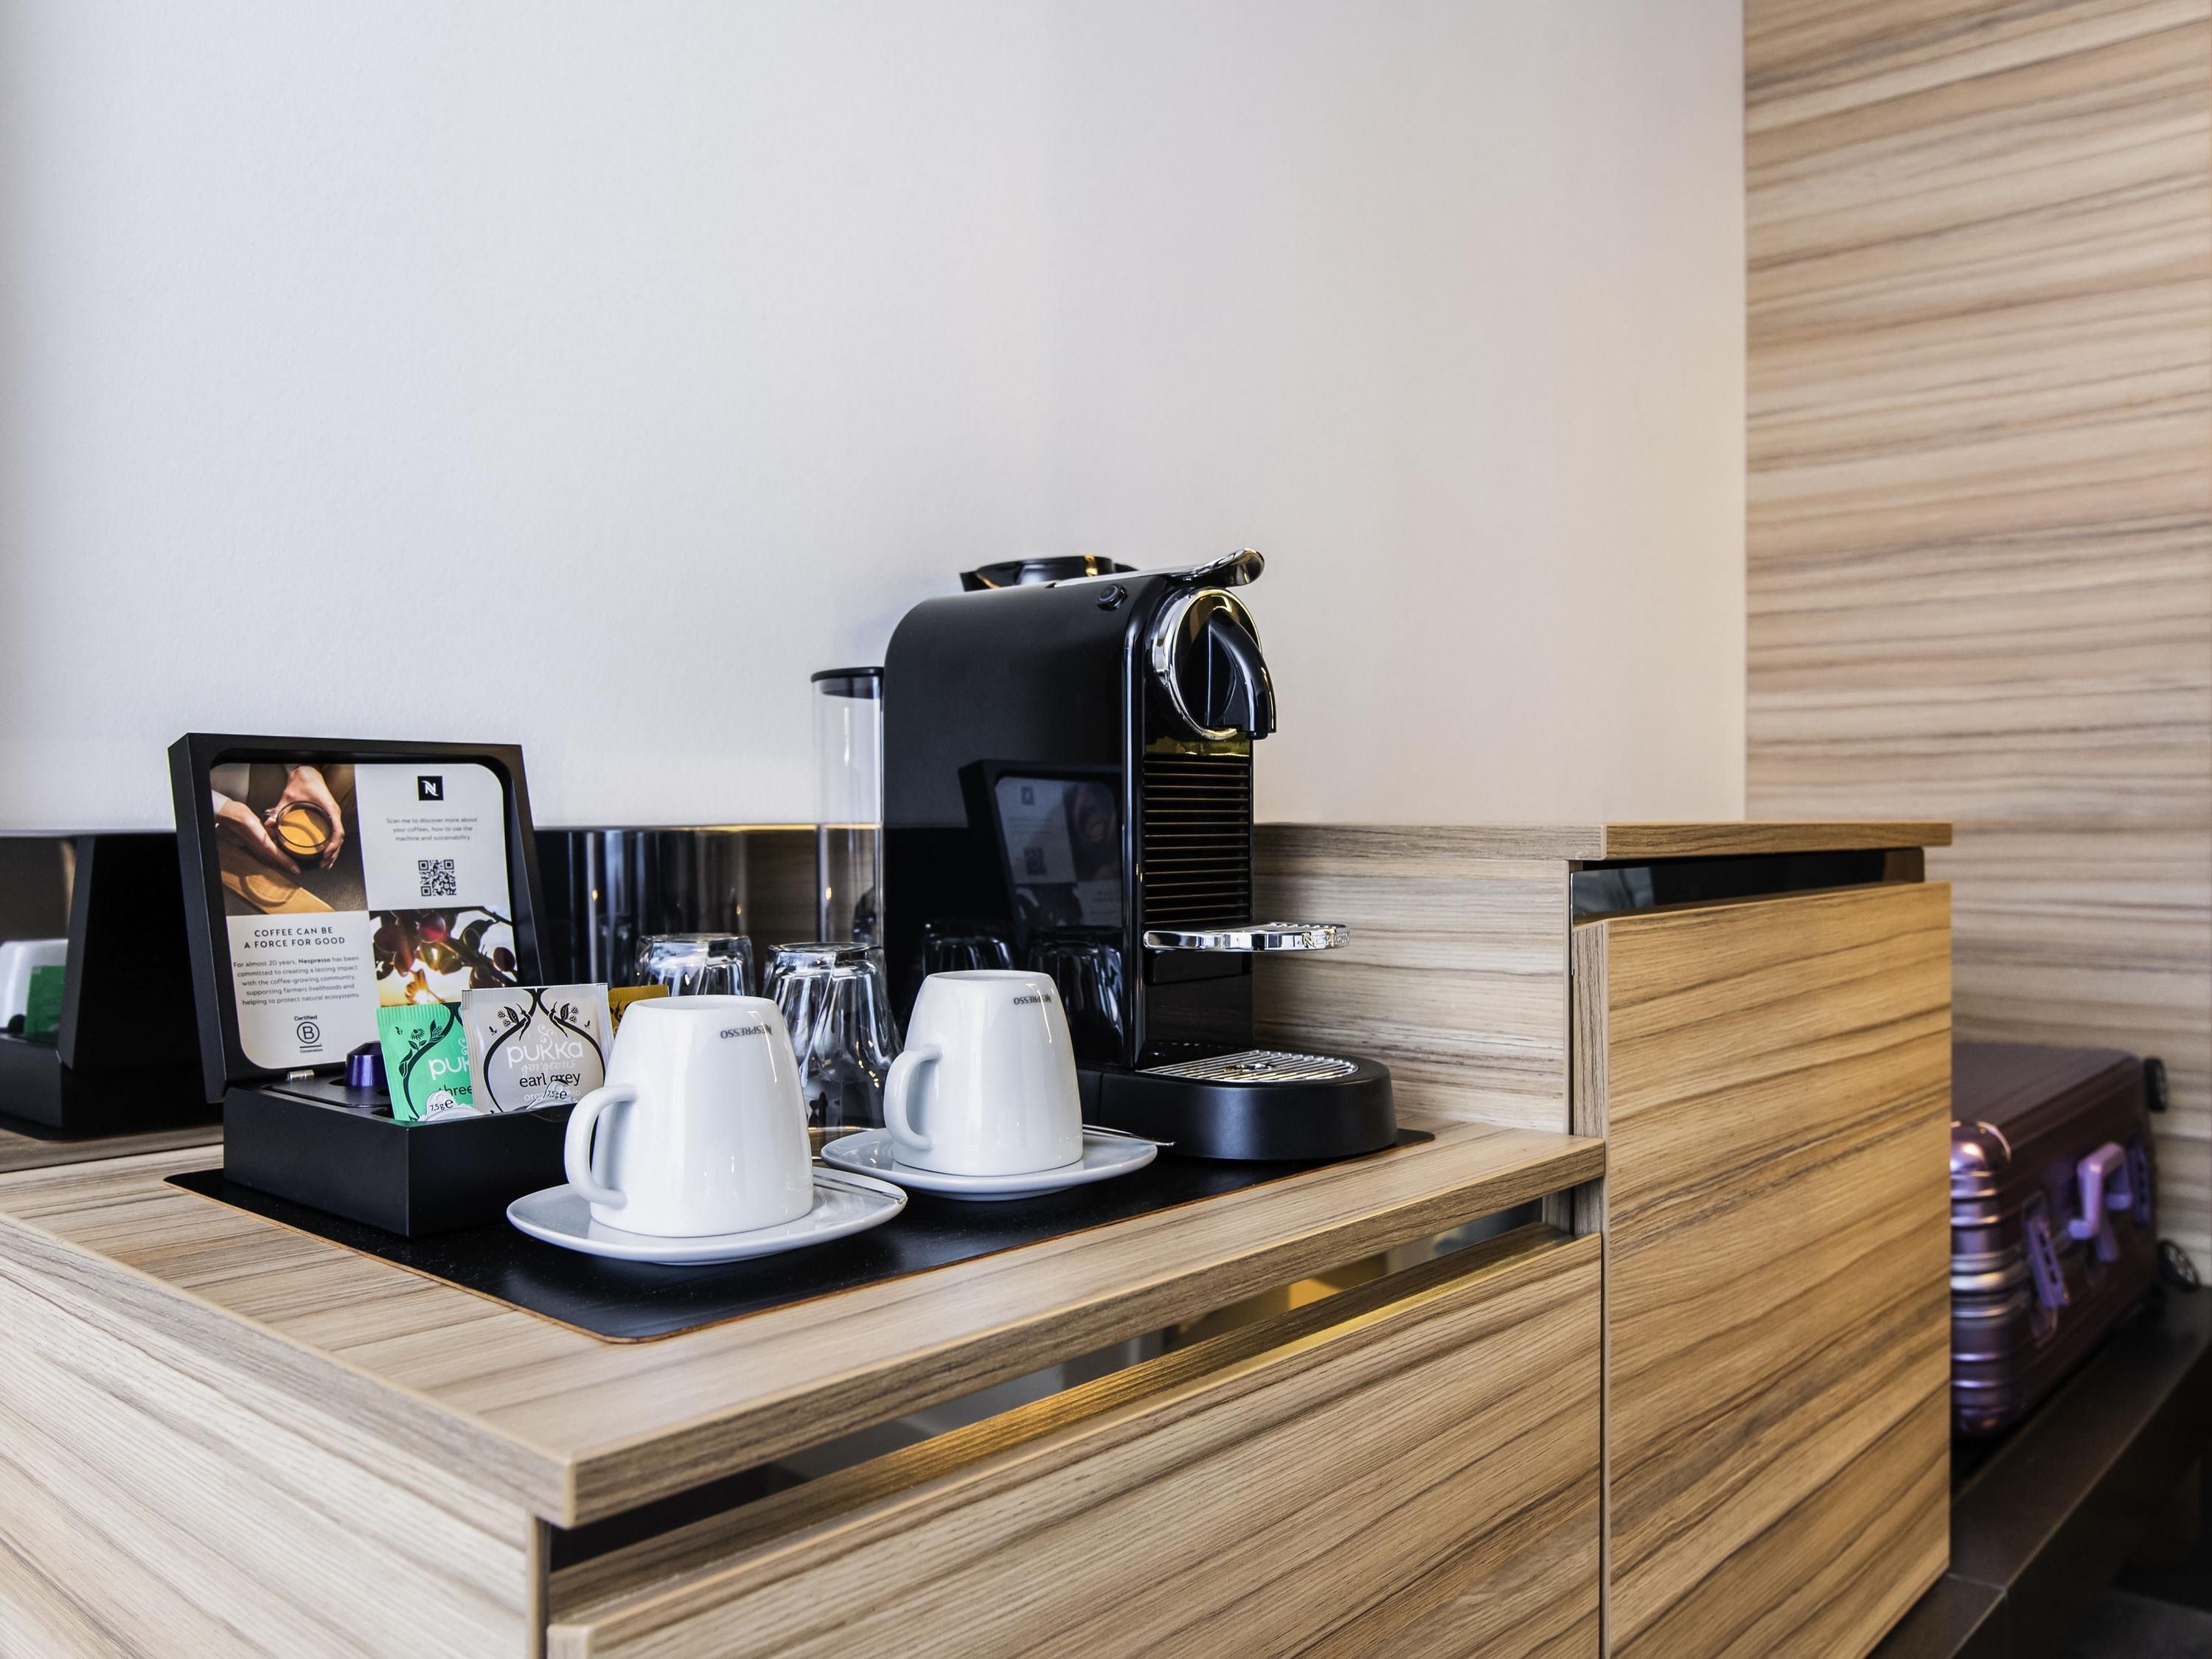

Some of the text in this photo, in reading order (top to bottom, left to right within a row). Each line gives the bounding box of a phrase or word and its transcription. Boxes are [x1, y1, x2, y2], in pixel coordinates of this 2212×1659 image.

[254, 926, 333, 937] COFFEE CAN BE
[254, 939, 288, 948] FORCE
[292, 938, 311, 946] FOR
[315, 937, 345, 945] GOOD
[270, 977, 319, 985] coffee-growing
[1013, 993, 1053, 1005] NEPRESSO
[302, 1026, 315, 1040] B
[507, 1041, 584, 1068] pukka
[519, 1072, 547, 1088] earl
[439, 1085, 473, 1096] hree
